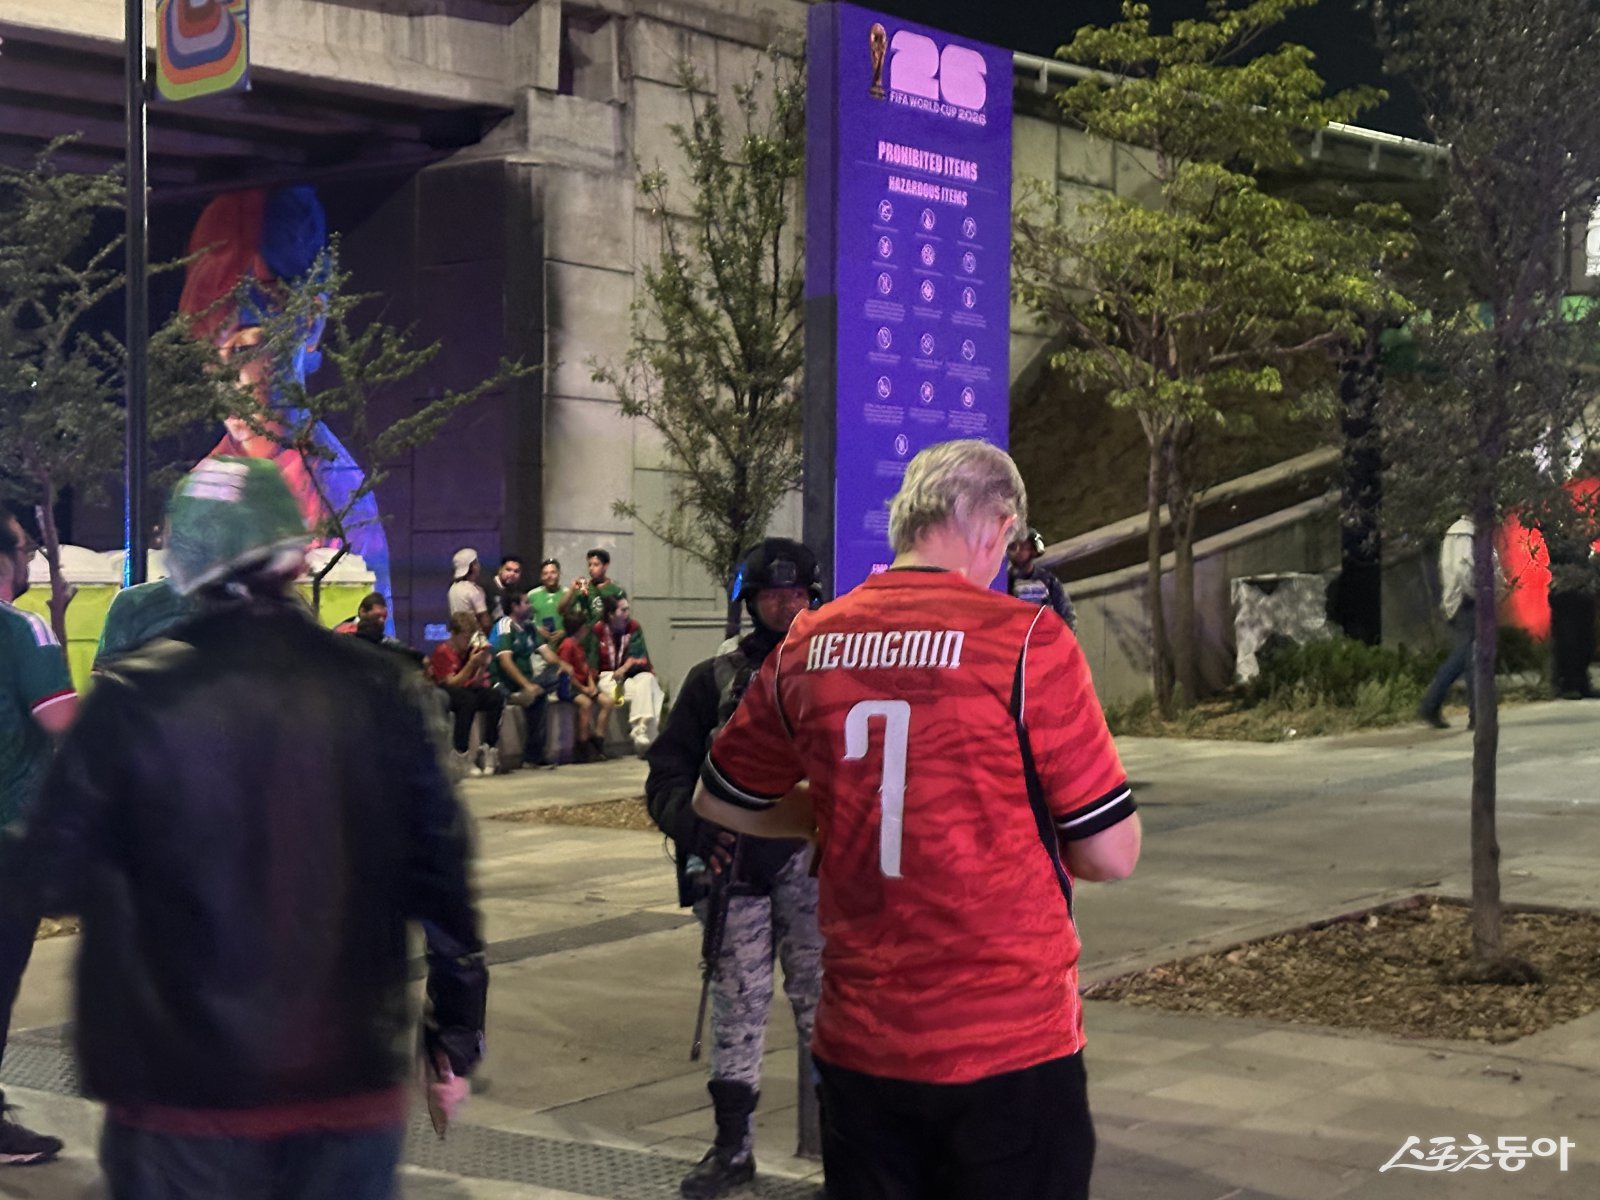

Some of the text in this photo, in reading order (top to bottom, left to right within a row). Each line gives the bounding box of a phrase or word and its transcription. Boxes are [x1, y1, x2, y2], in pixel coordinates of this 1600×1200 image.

[890, 30, 987, 110] 26
[890, 90, 987, 127] FIFA WORLD CUP 2026
[878, 140, 978, 183] PROHIBITED ITEMS
[888, 175, 968, 209] HAZARDOUS ITEMS
[806, 630, 965, 672] HEUNGMIN
[843, 699, 911, 879] 7
